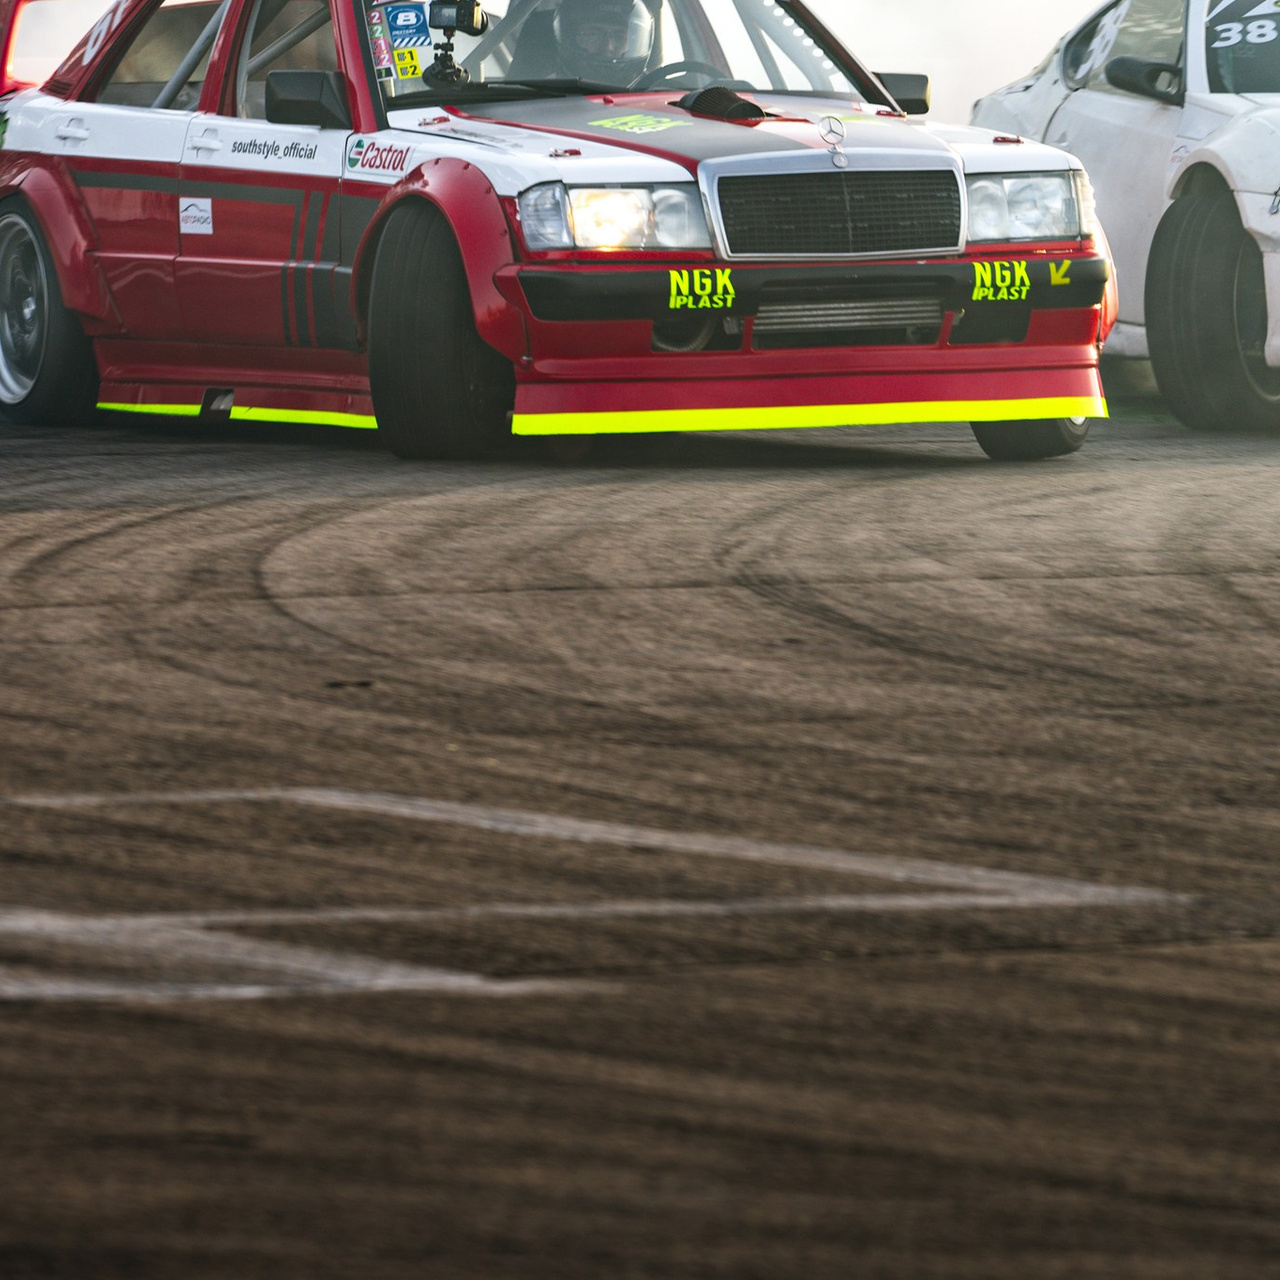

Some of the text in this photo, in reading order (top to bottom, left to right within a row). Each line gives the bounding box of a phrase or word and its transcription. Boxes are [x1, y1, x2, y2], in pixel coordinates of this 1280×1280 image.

[1210, 19, 1279, 48] 38
[231, 138, 318, 160] southstyle_official
[360, 141, 411, 172] Castrol
[668, 268, 736, 296] NGK
[972, 260, 1031, 287] NGK
